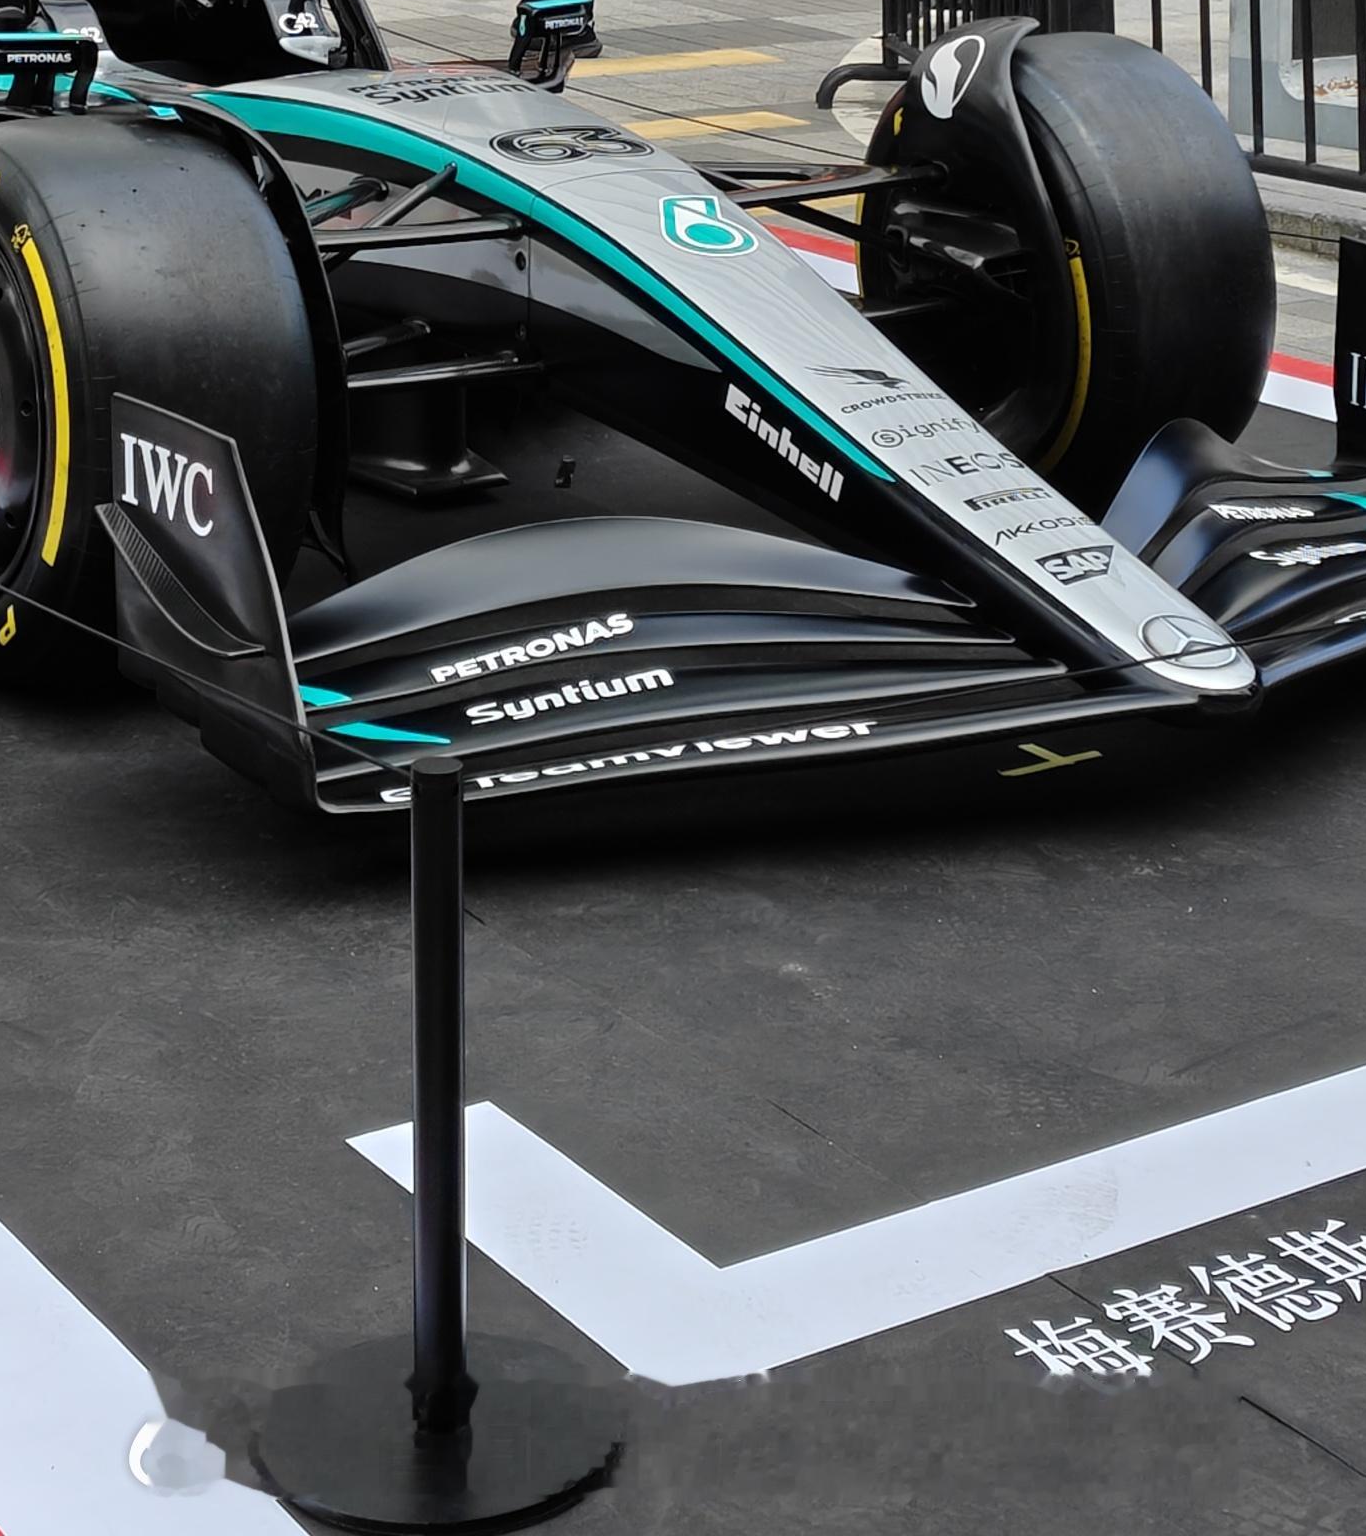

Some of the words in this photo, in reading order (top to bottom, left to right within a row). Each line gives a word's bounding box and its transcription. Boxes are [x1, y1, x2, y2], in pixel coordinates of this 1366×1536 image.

[6, 52, 72, 64] PETRONAS
[364, 80, 535, 105] Syntium
[489, 125, 656, 165] 63
[840, 392, 947, 415] CROWDSTRIKE
[725, 383, 844, 502] Einhell
[120, 433, 214, 537] IWC
[908, 452, 1025, 487] INEOS
[963, 487, 1052, 511] PIRELLI
[1042, 550, 1110, 580] SAP
[430, 612, 634, 684] PETRONAS
[465, 668, 675, 725] Syntium
